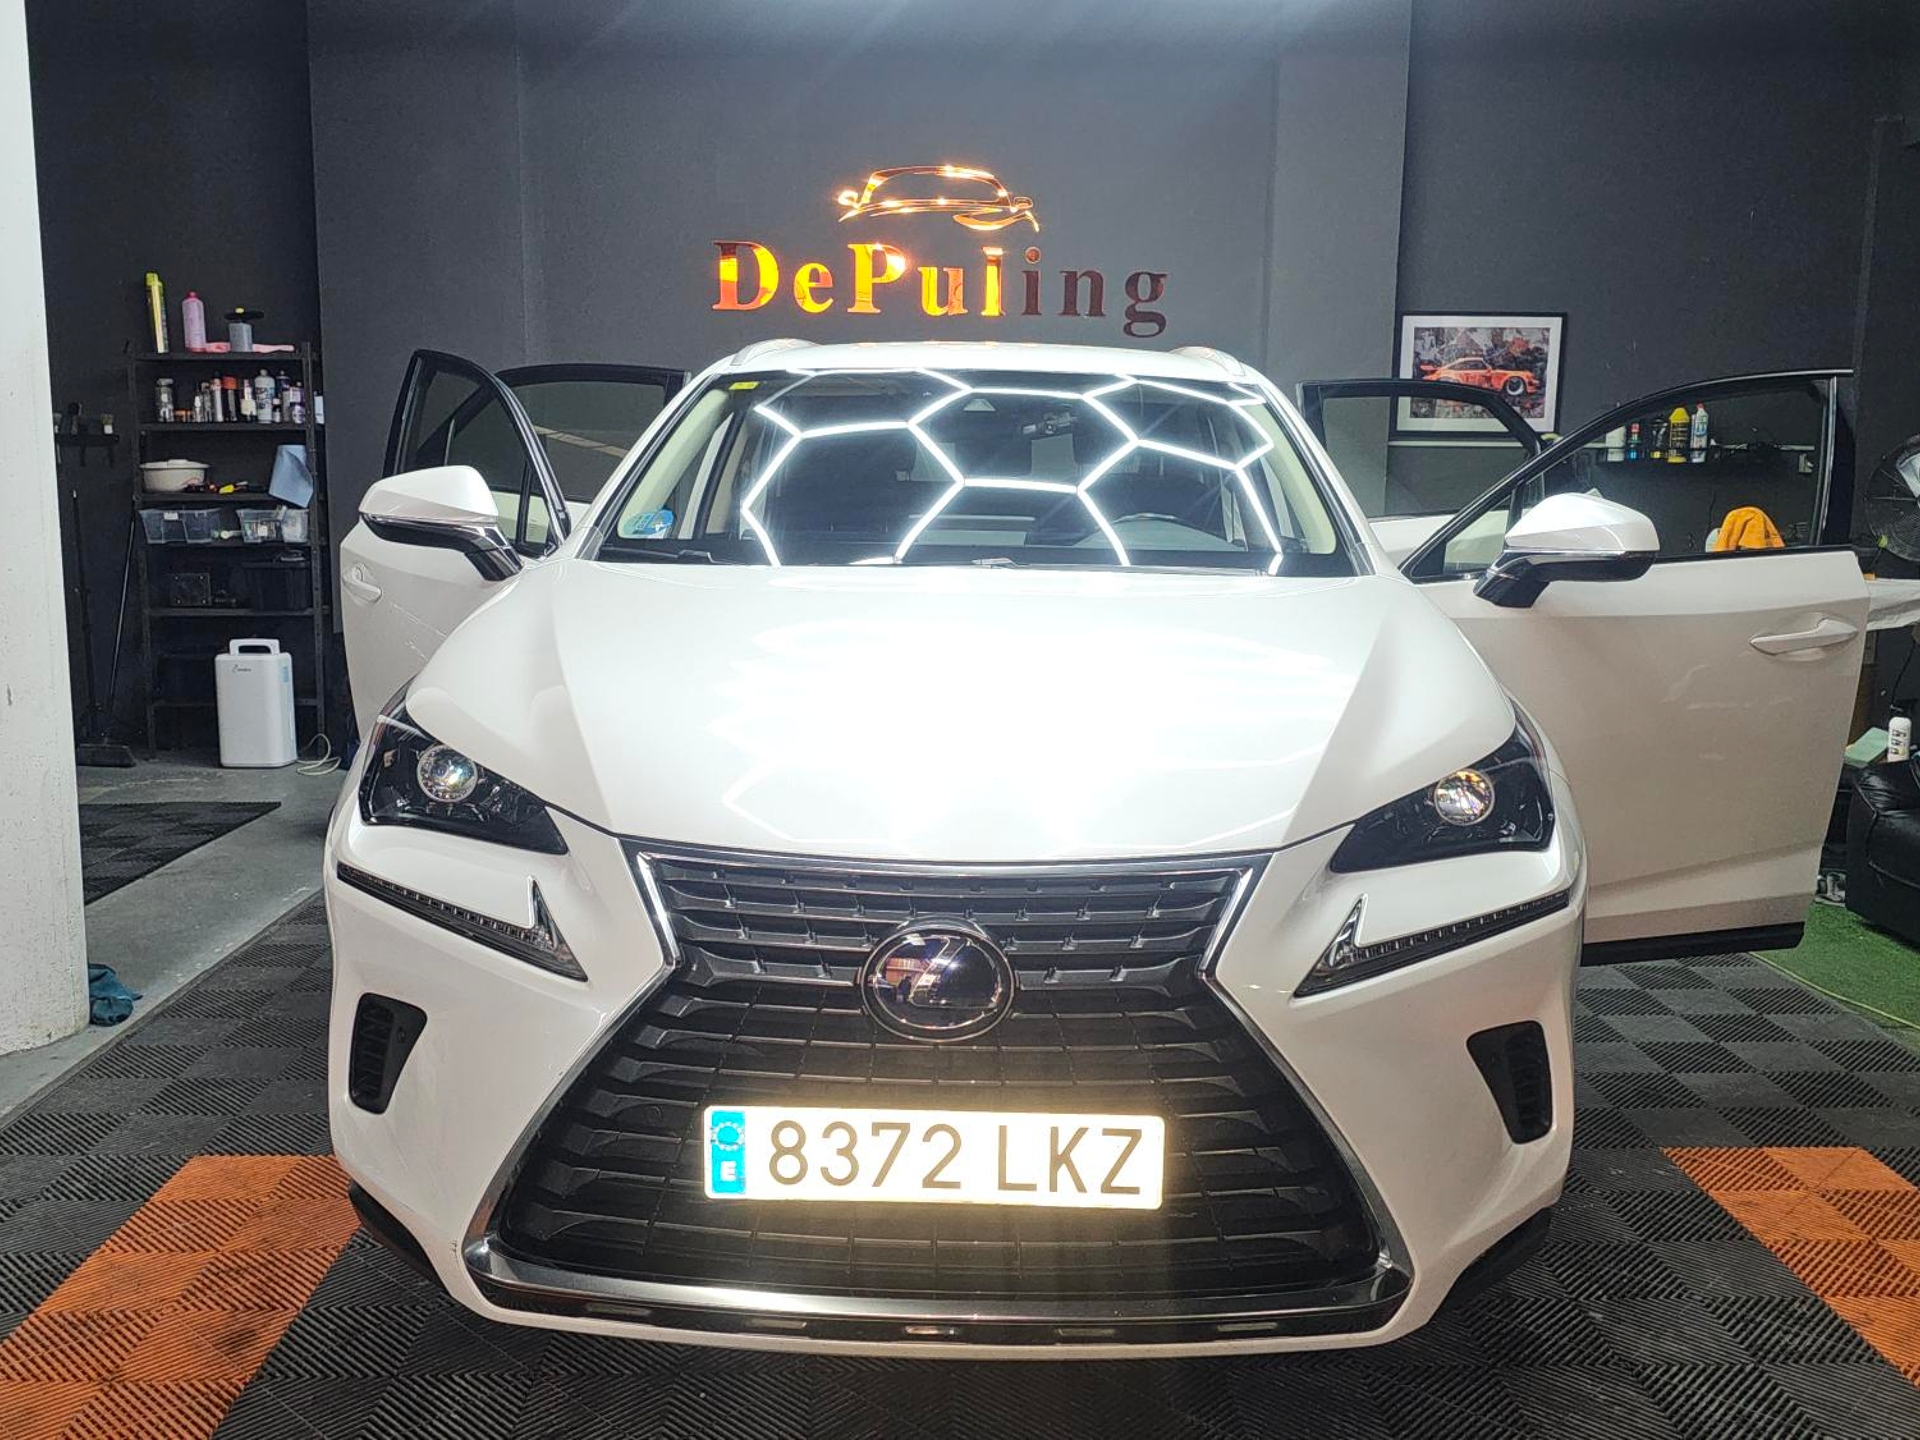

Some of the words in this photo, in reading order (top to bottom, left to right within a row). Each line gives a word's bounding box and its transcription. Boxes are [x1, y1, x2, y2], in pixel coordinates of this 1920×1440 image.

[711, 240, 1168, 338] DePuling
[720, 1160, 737, 1182] E
[768, 1119, 962, 1190] 8372
[997, 1124, 1143, 1195] LKZ
